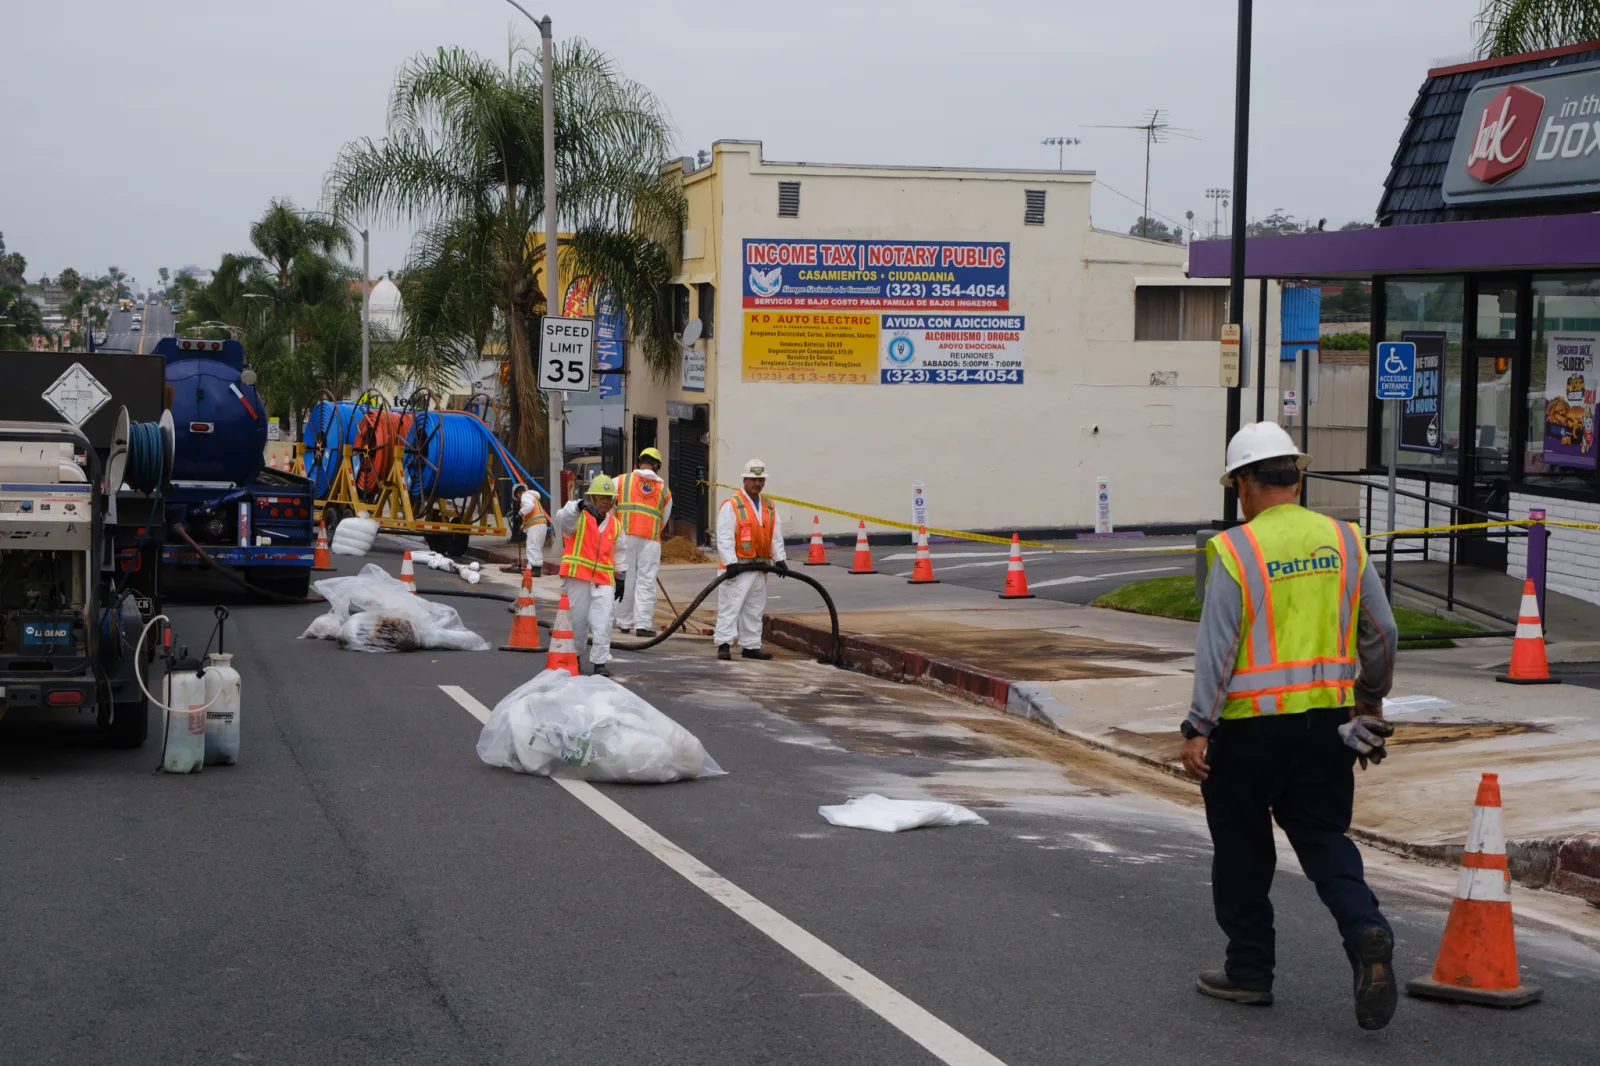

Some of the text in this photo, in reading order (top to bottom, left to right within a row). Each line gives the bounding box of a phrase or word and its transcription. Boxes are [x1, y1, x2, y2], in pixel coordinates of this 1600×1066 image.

[1560, 95, 1600, 118] in th
[747, 244, 817, 265] INCOME
[820, 244, 856, 266] TAX
[868, 245, 939, 267] NOTARY
[941, 247, 1005, 268] PUBLIC
[798, 270, 955, 282] CASAMIENTOS CIUDADANIA
[886, 284, 1006, 298] (323) 354-4054
[751, 315, 871, 325] K D AUTO ELECTRIC
[886, 318, 1020, 329] AYUDA CON ADICCIONES
[546, 325, 589, 338] SPEED
[925, 332, 981, 341] ALCOHOLISMO
[988, 332, 1019, 341] DROGAS
[550, 342, 583, 354] LIMIT
[1557, 344, 1578, 355] SMASHED
[950, 352, 994, 360] REUNIONES
[1563, 356, 1584, 371] SLIDERS
[547, 359, 584, 383] 35
[887, 370, 1018, 382] (323) 354-4054
[787, 373, 867, 383] 413-5731
[1415, 371, 1438, 396] PEN
[1406, 398, 1437, 414] 24 HOURS
[1266, 553, 1339, 578] Patriot
